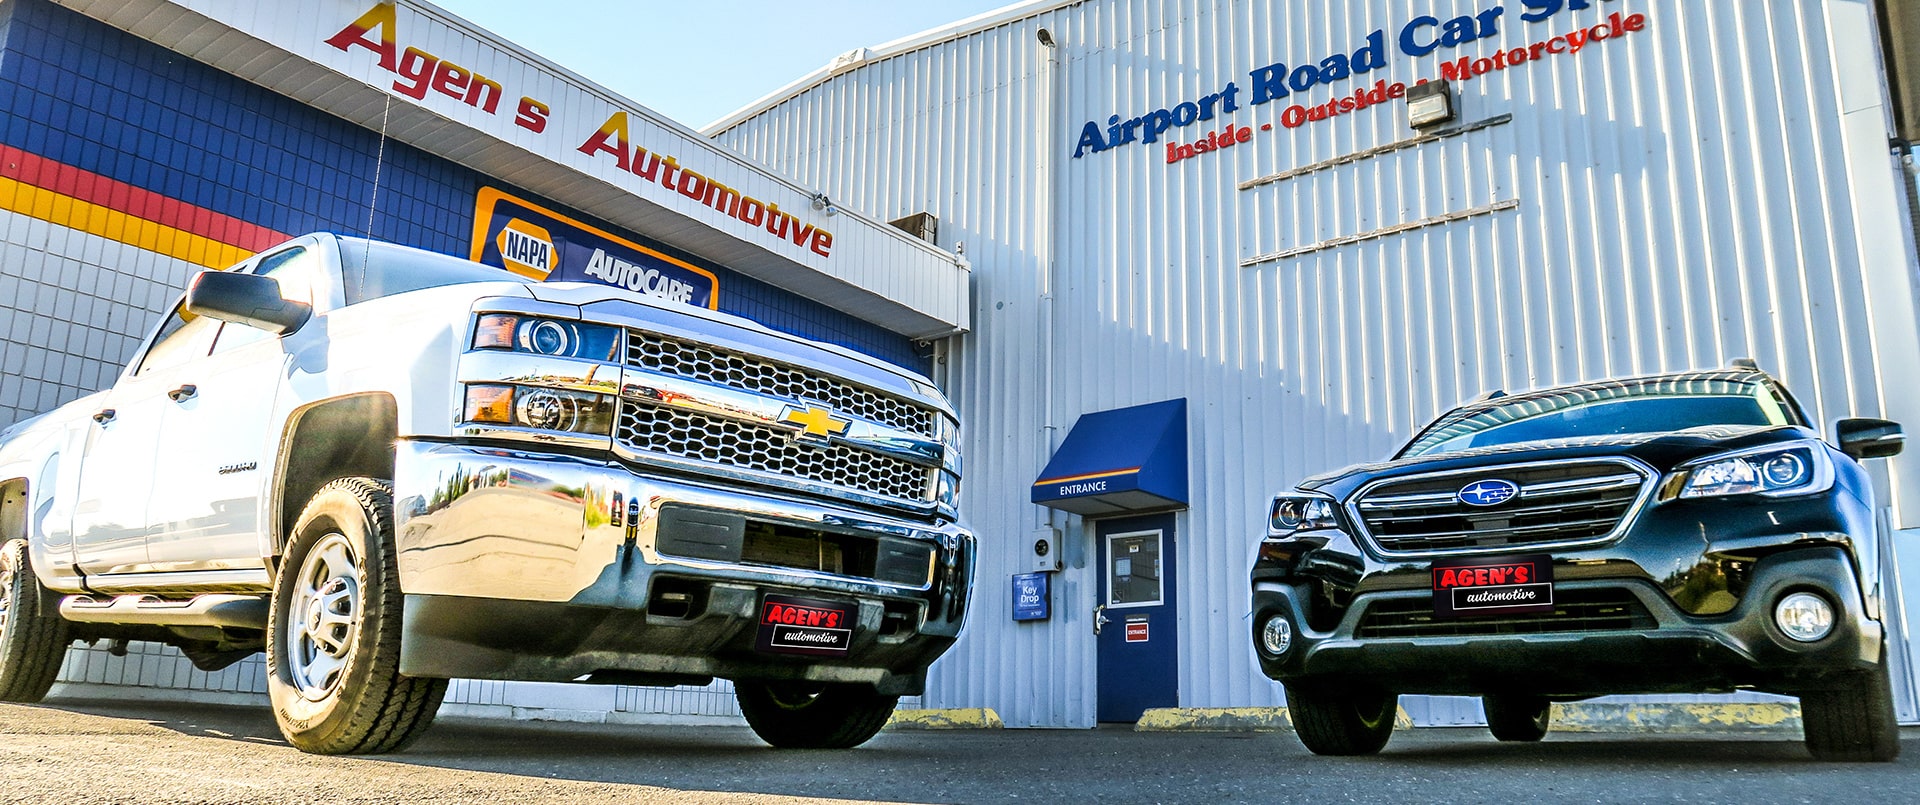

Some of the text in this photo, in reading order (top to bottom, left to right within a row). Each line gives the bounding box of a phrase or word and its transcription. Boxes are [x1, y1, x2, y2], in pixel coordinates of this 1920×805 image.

[1073, 6, 1504, 159] Airport Road Car
[1166, 123, 1251, 164] Inside
[1281, 79, 1405, 128] Outside
[1440, 11, 1645, 82] Motorcycle
[577, 111, 834, 259] Automotive
[506, 232, 548, 270] NAPA
[1060, 480, 1107, 496] ENTRANCE
[1440, 566, 1529, 587] AGEN'S
[1020, 594, 1040, 604] Drop
[1022, 586, 1038, 596] Key
[1466, 588, 1537, 603] automotive
[767, 604, 839, 628] AGEN'S
[784, 630, 838, 644] automotive
